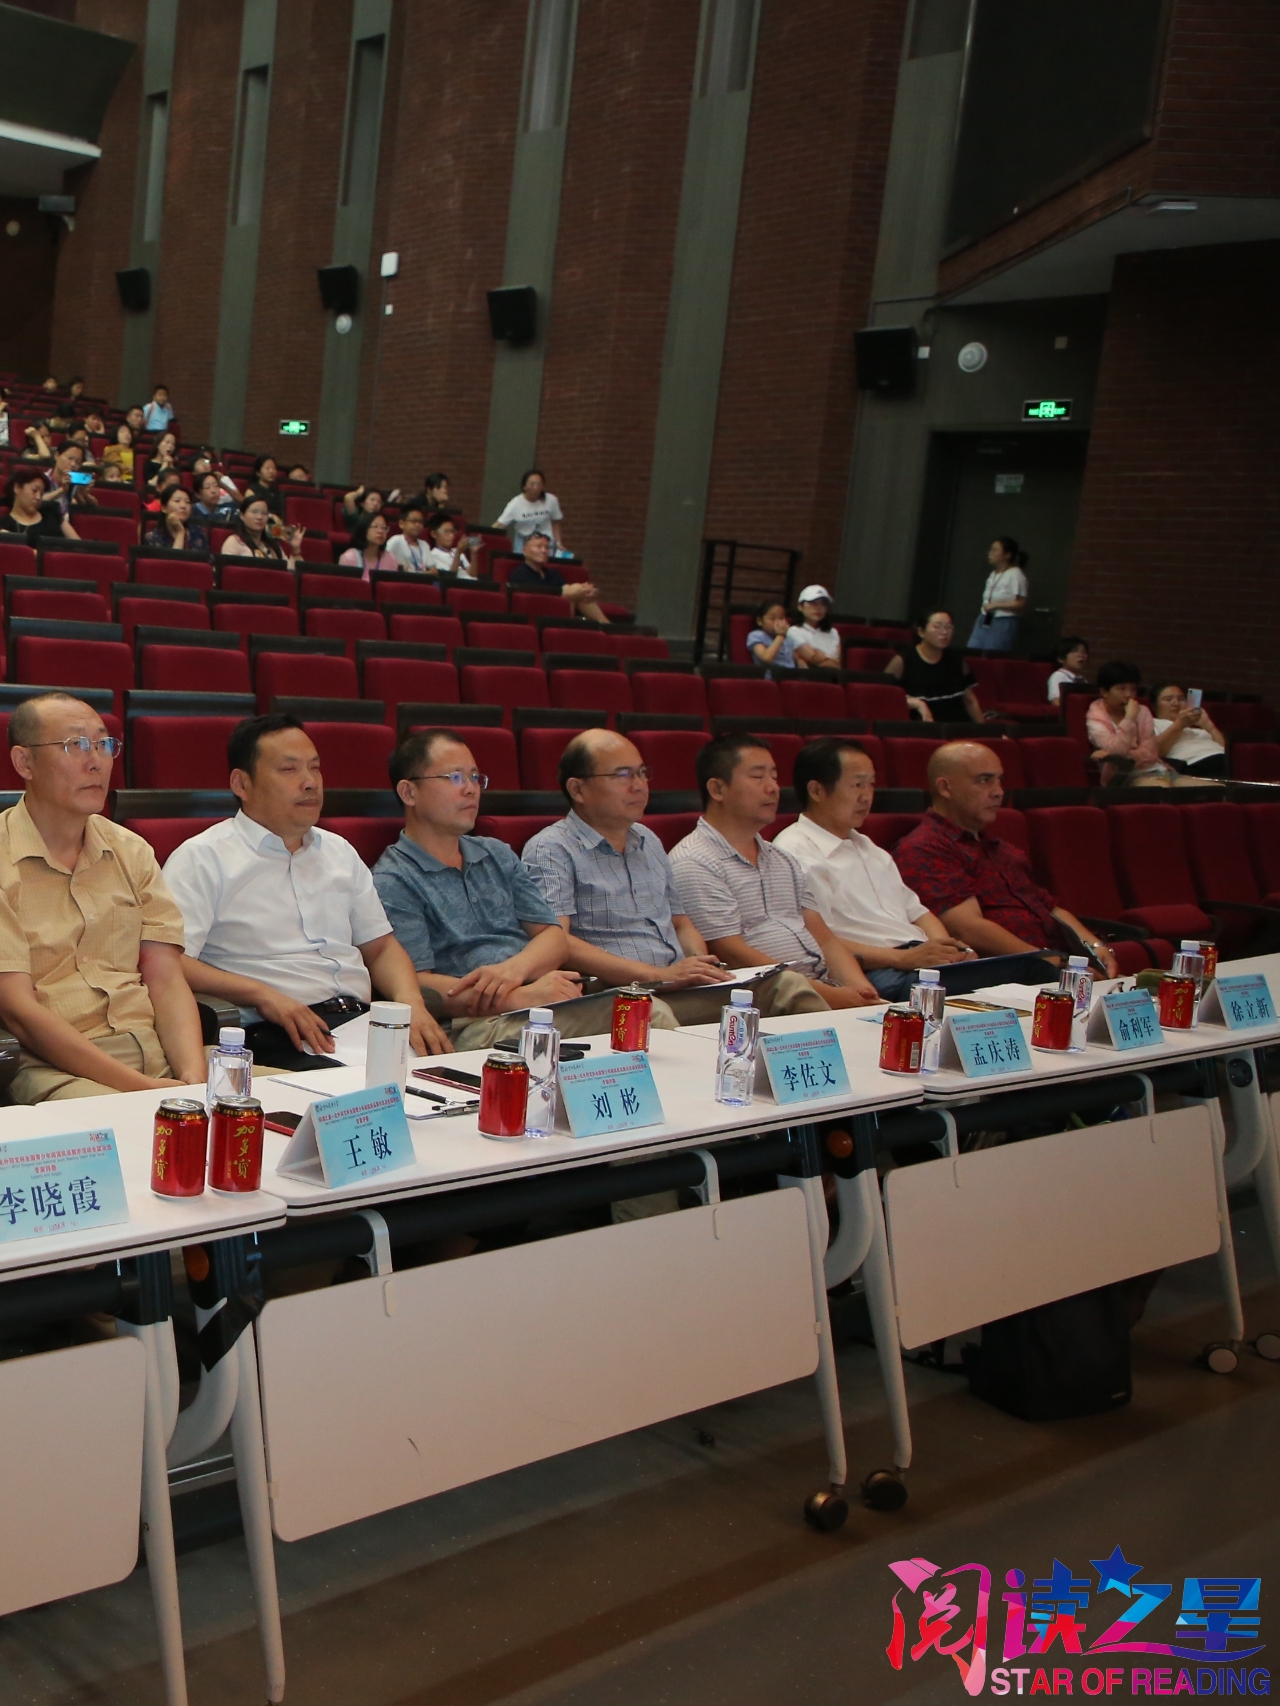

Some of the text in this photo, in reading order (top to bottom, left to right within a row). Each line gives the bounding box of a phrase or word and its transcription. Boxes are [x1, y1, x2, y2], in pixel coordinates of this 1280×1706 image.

[971, 1037, 1020, 1066] 孟庆涛
[781, 1060, 837, 1092] 李佐文
[591, 1087, 640, 1120] 刘彬
[343, 1126, 392, 1170] 王敏
